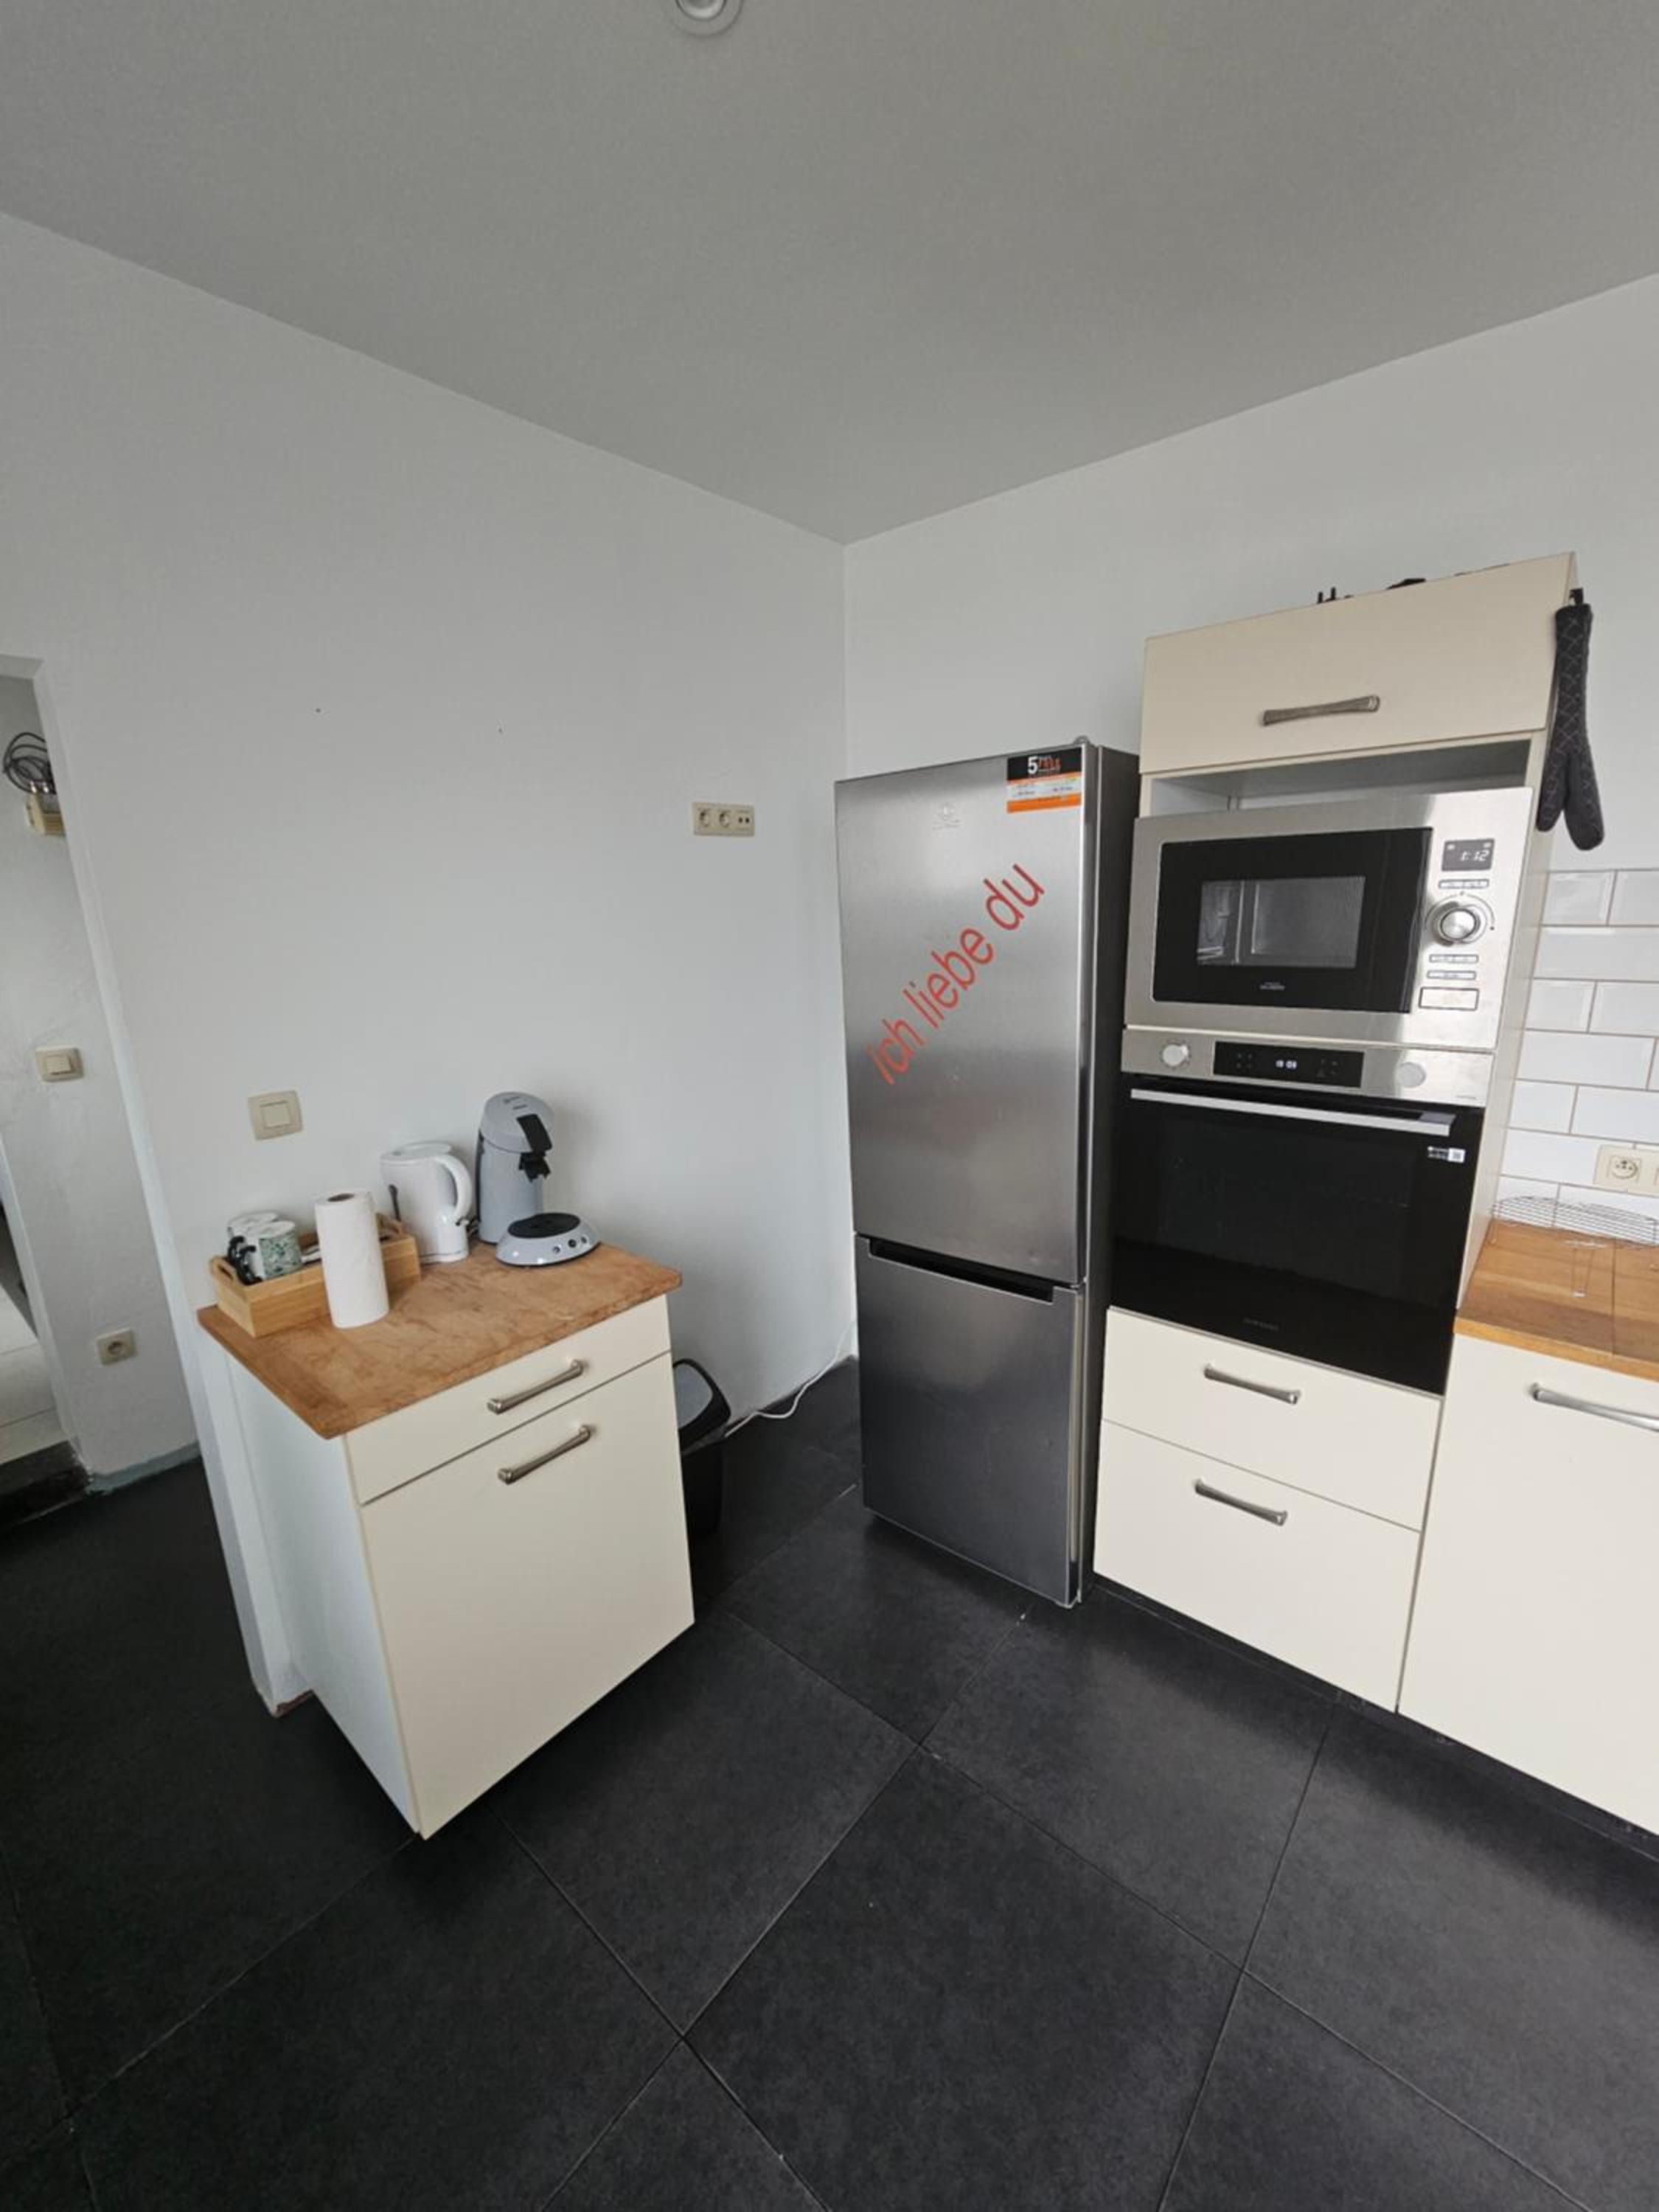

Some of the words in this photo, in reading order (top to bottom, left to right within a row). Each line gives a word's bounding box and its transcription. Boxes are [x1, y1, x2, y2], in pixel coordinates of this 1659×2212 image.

[1028, 756, 1038, 774] 5
[902, 927, 993, 1028] liebe
[983, 863, 1045, 931] du
